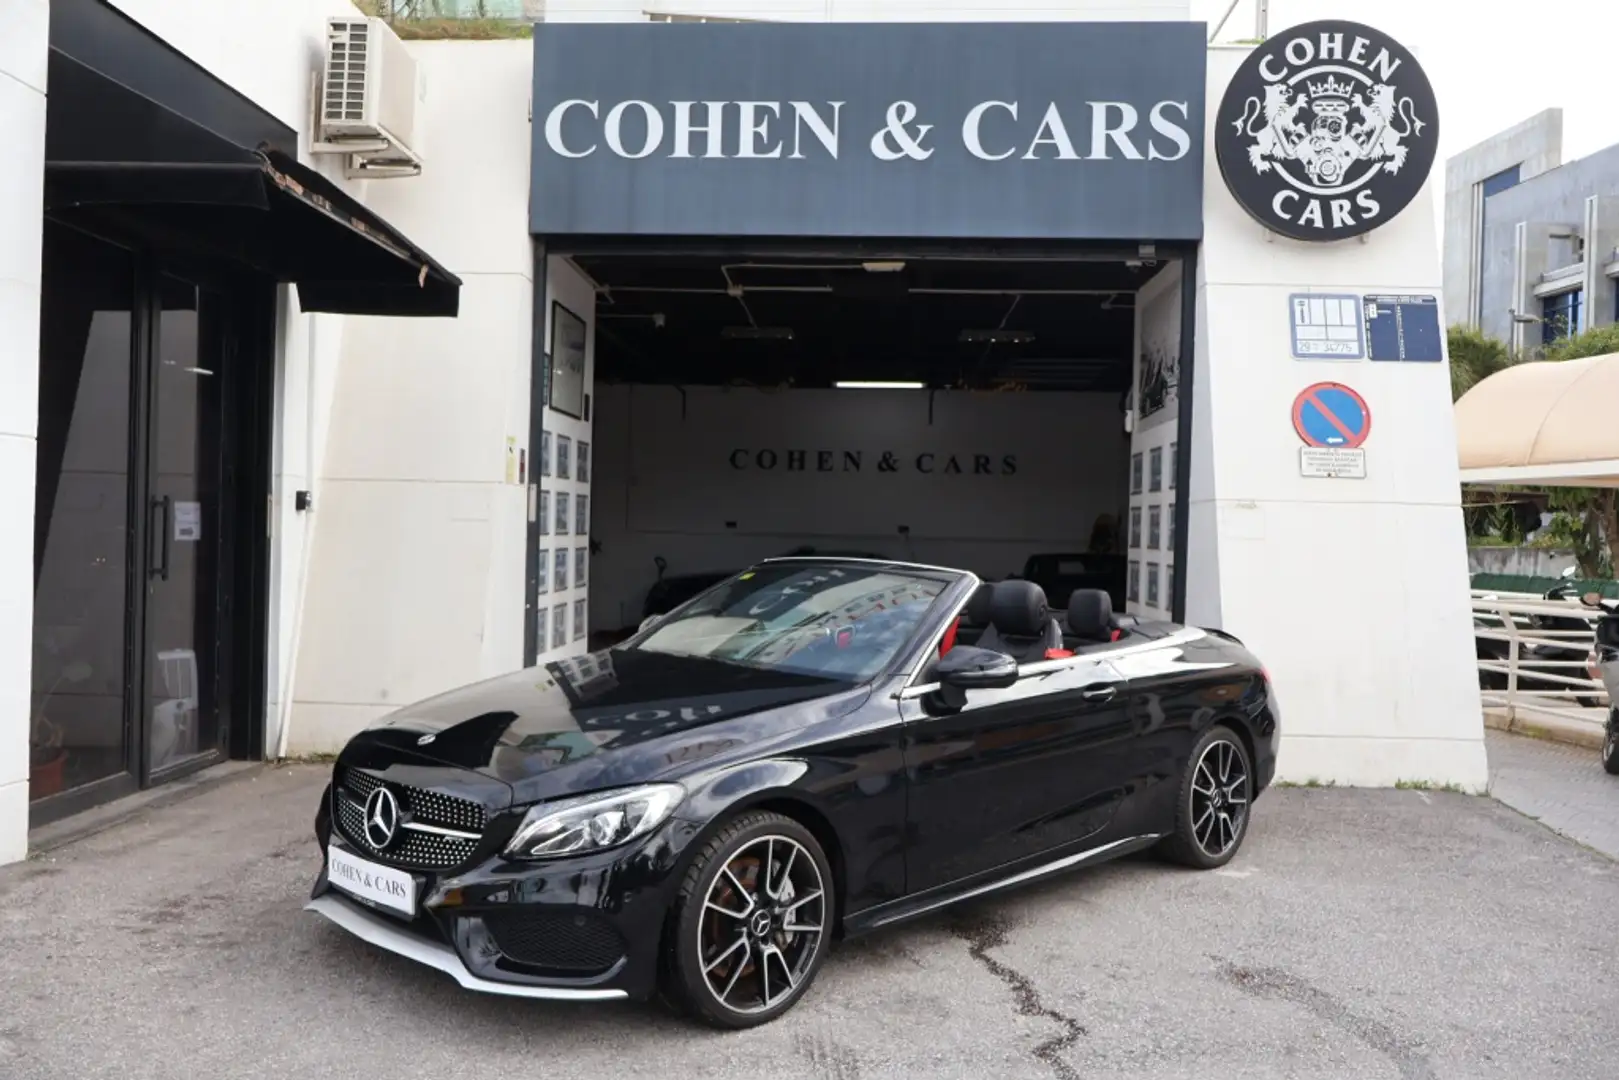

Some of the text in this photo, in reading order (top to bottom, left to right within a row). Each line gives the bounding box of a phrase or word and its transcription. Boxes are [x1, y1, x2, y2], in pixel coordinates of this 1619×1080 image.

[1258, 31, 1402, 83] COHEN
[544, 99, 1191, 161] COHEN & CARS
[1271, 188, 1381, 229] CARS
[728, 449, 1018, 477] COHEN & CARS
[331, 857, 407, 899] COHEN & CARS
